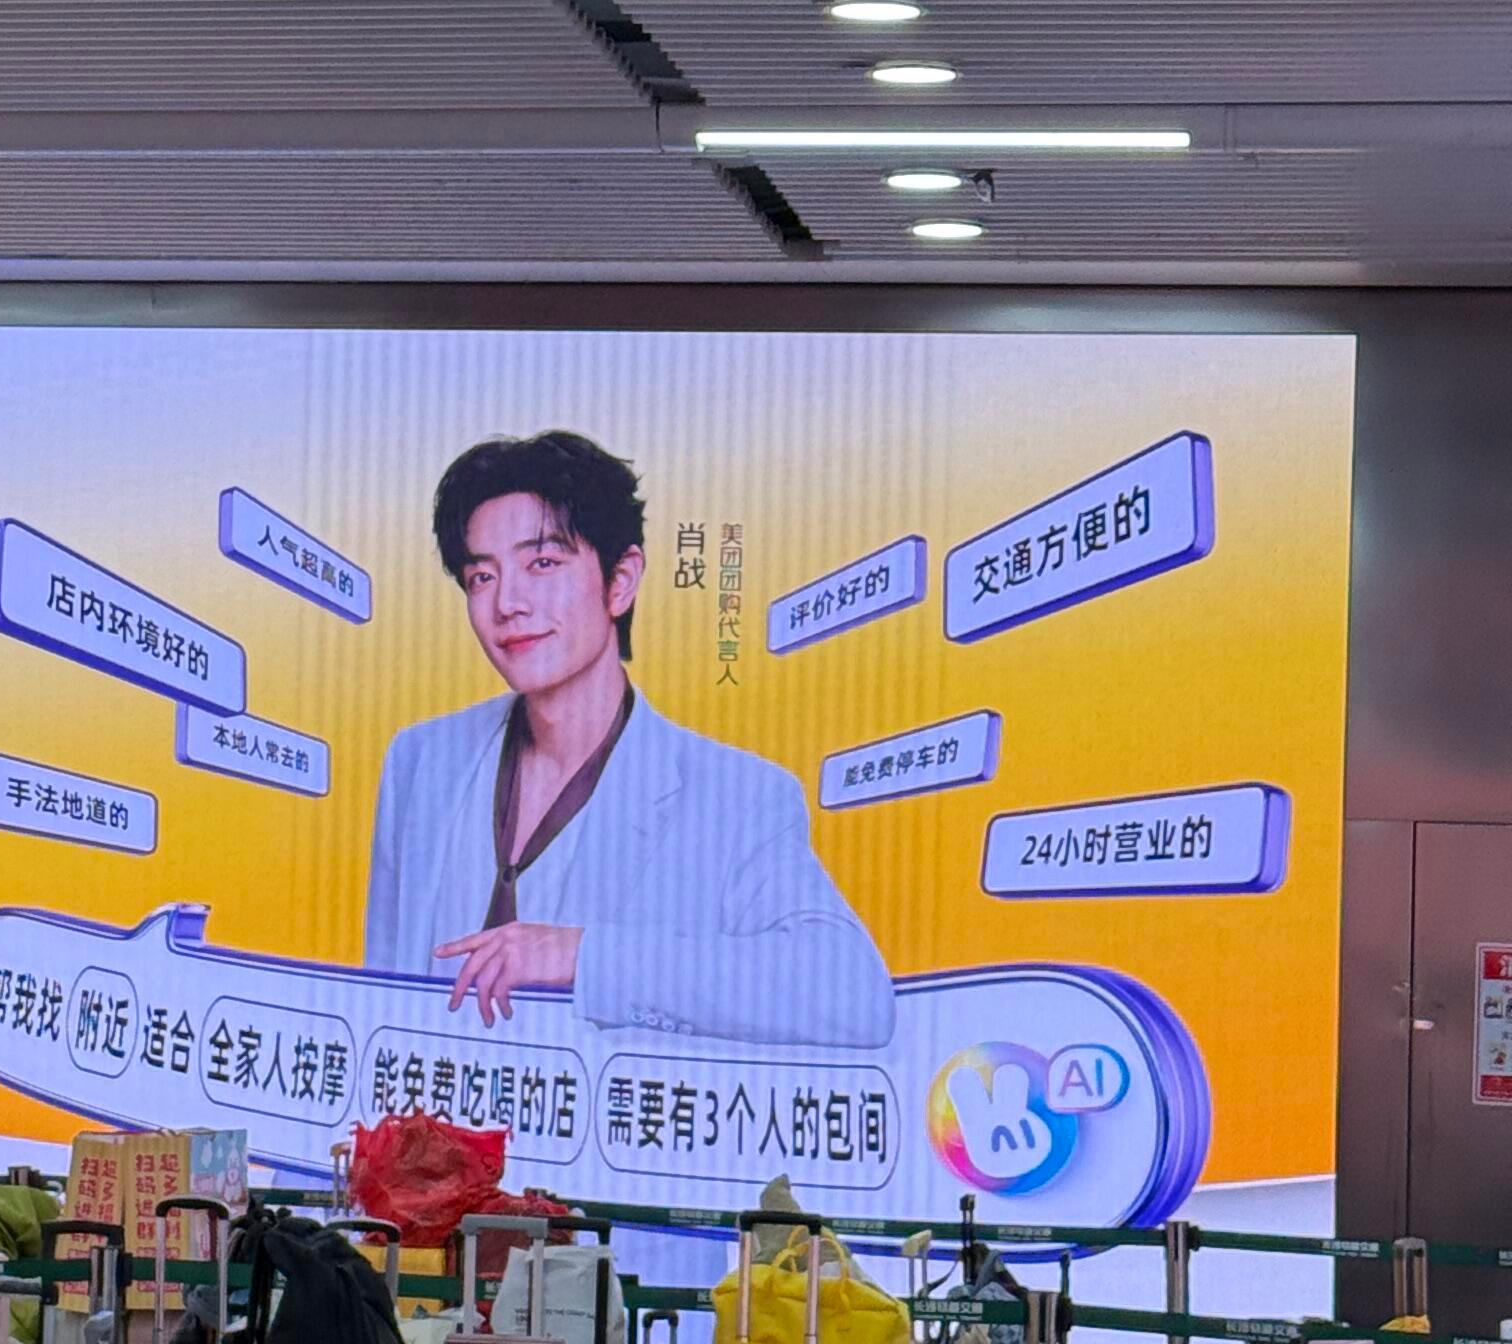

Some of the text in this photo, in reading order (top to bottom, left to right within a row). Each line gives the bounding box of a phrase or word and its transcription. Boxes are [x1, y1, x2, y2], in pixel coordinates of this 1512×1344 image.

[257, 525, 354, 597] 人气超高的
[674, 523, 706, 590] 肖战
[972, 485, 1152, 604] 交通方便的
[47, 573, 209, 681] 店内环境好的
[717, 522, 744, 687] 美团团购代言人
[789, 563, 890, 629] 评价好的
[213, 723, 309, 773] 本地人常去的
[843, 737, 959, 788] 能免费停车的
[6, 777, 129, 830] 手法地道的
[1021, 813, 1212, 866] 24小时营业的
[74, 988, 130, 1060] 附近
[139, 1004, 197, 1074] 适合
[207, 1019, 349, 1107] 全家人按摩
[371, 1046, 578, 1138] 能免费吃喝的店
[606, 1076, 888, 1166] 需要有3个人的包间
[1056, 1056, 1107, 1100] AI
